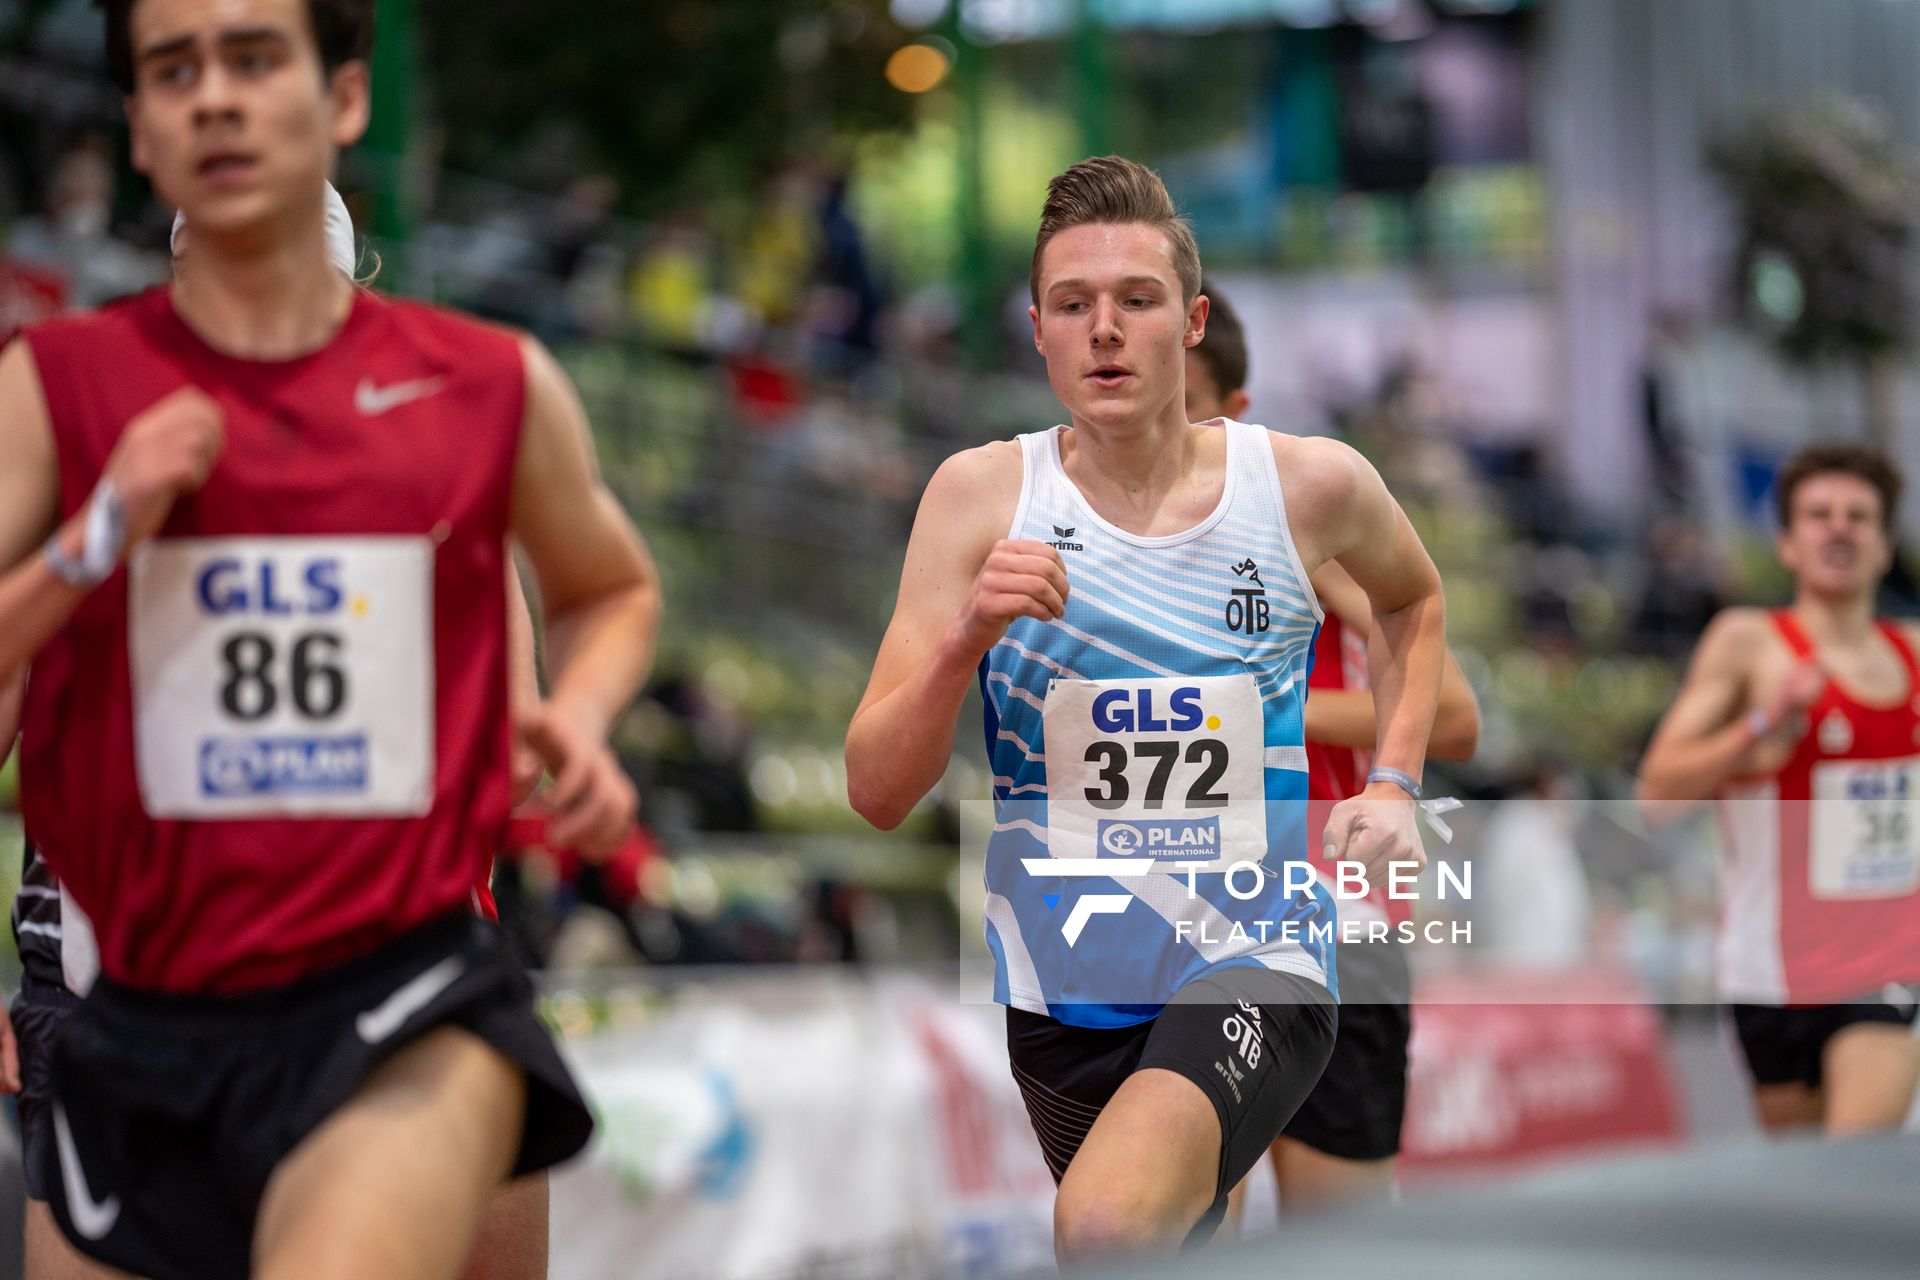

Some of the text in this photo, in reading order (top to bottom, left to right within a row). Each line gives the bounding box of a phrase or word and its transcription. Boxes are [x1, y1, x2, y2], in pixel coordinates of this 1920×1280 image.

[1226, 589, 1270, 635] OTB
[218, 631, 347, 721] 86
[1084, 739, 1229, 811] 372
[1148, 826, 1215, 846] PLAN
[1148, 848, 1215, 856] INTERNATIONAL
[1222, 1013, 1263, 1070] OTB
